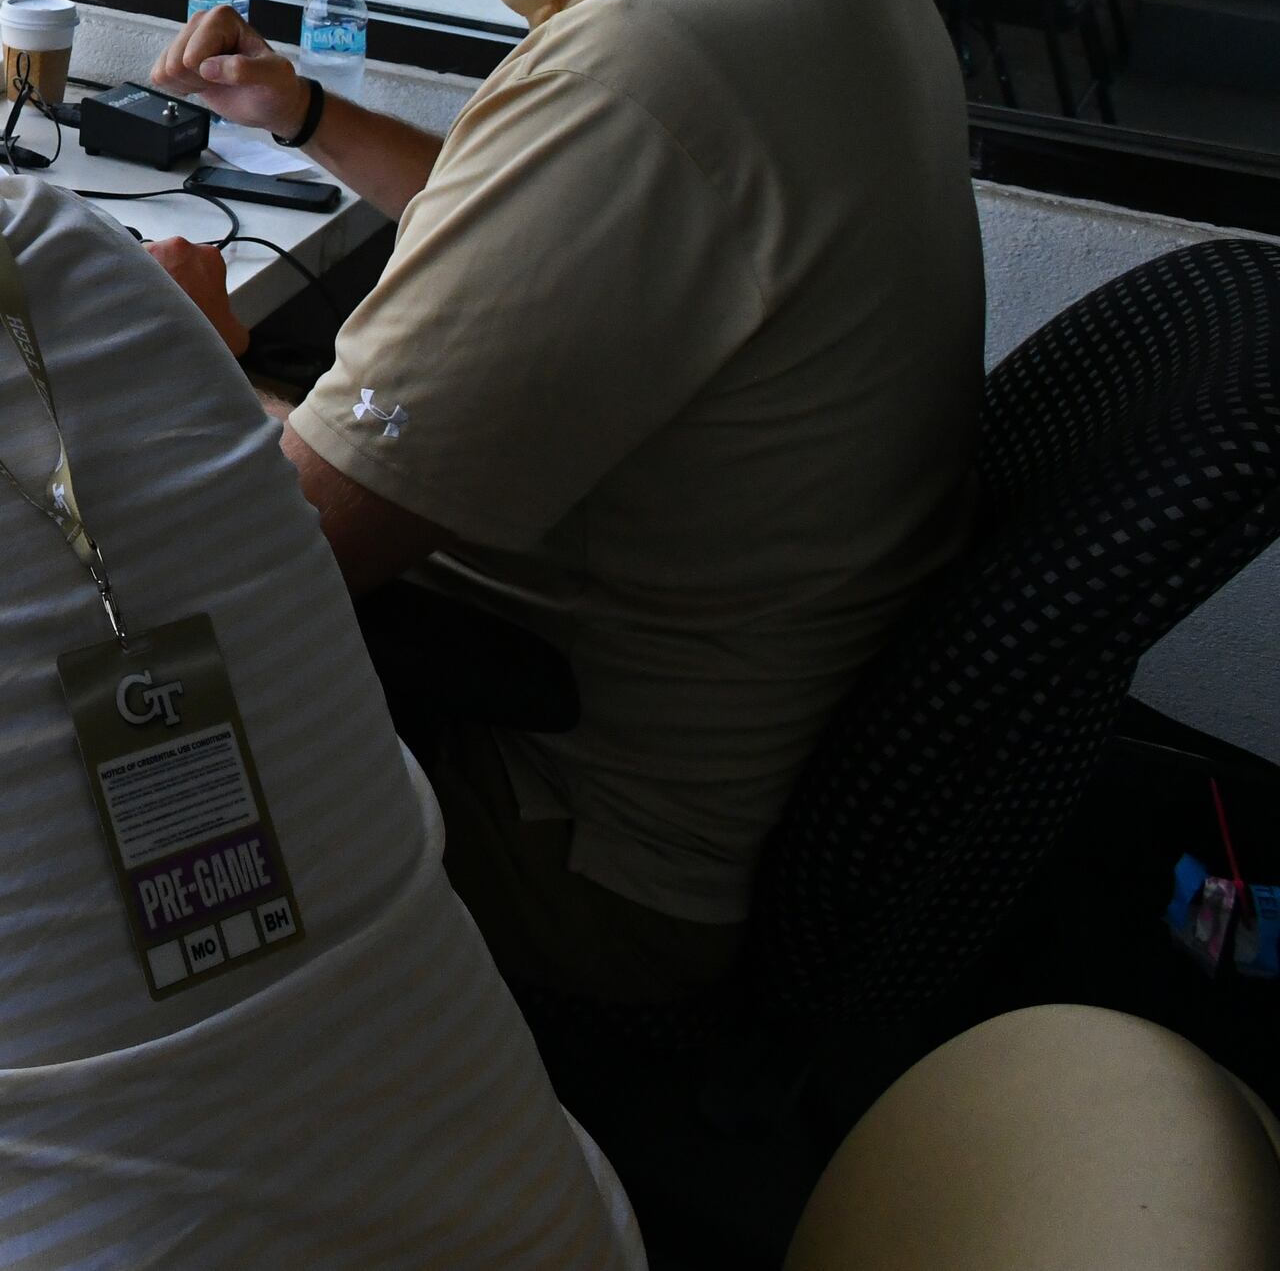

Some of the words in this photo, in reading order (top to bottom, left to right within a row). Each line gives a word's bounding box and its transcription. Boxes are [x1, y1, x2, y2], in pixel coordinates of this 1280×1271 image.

[101, 765, 126, 780] NOTICE
[137, 750, 178, 769] CREDENTIAL
[191, 732, 232, 751] CONDITIONS
[137, 838, 272, 930] PRE-GAME
[264, 905, 289, 933] BH
[191, 938, 217, 962] MO
